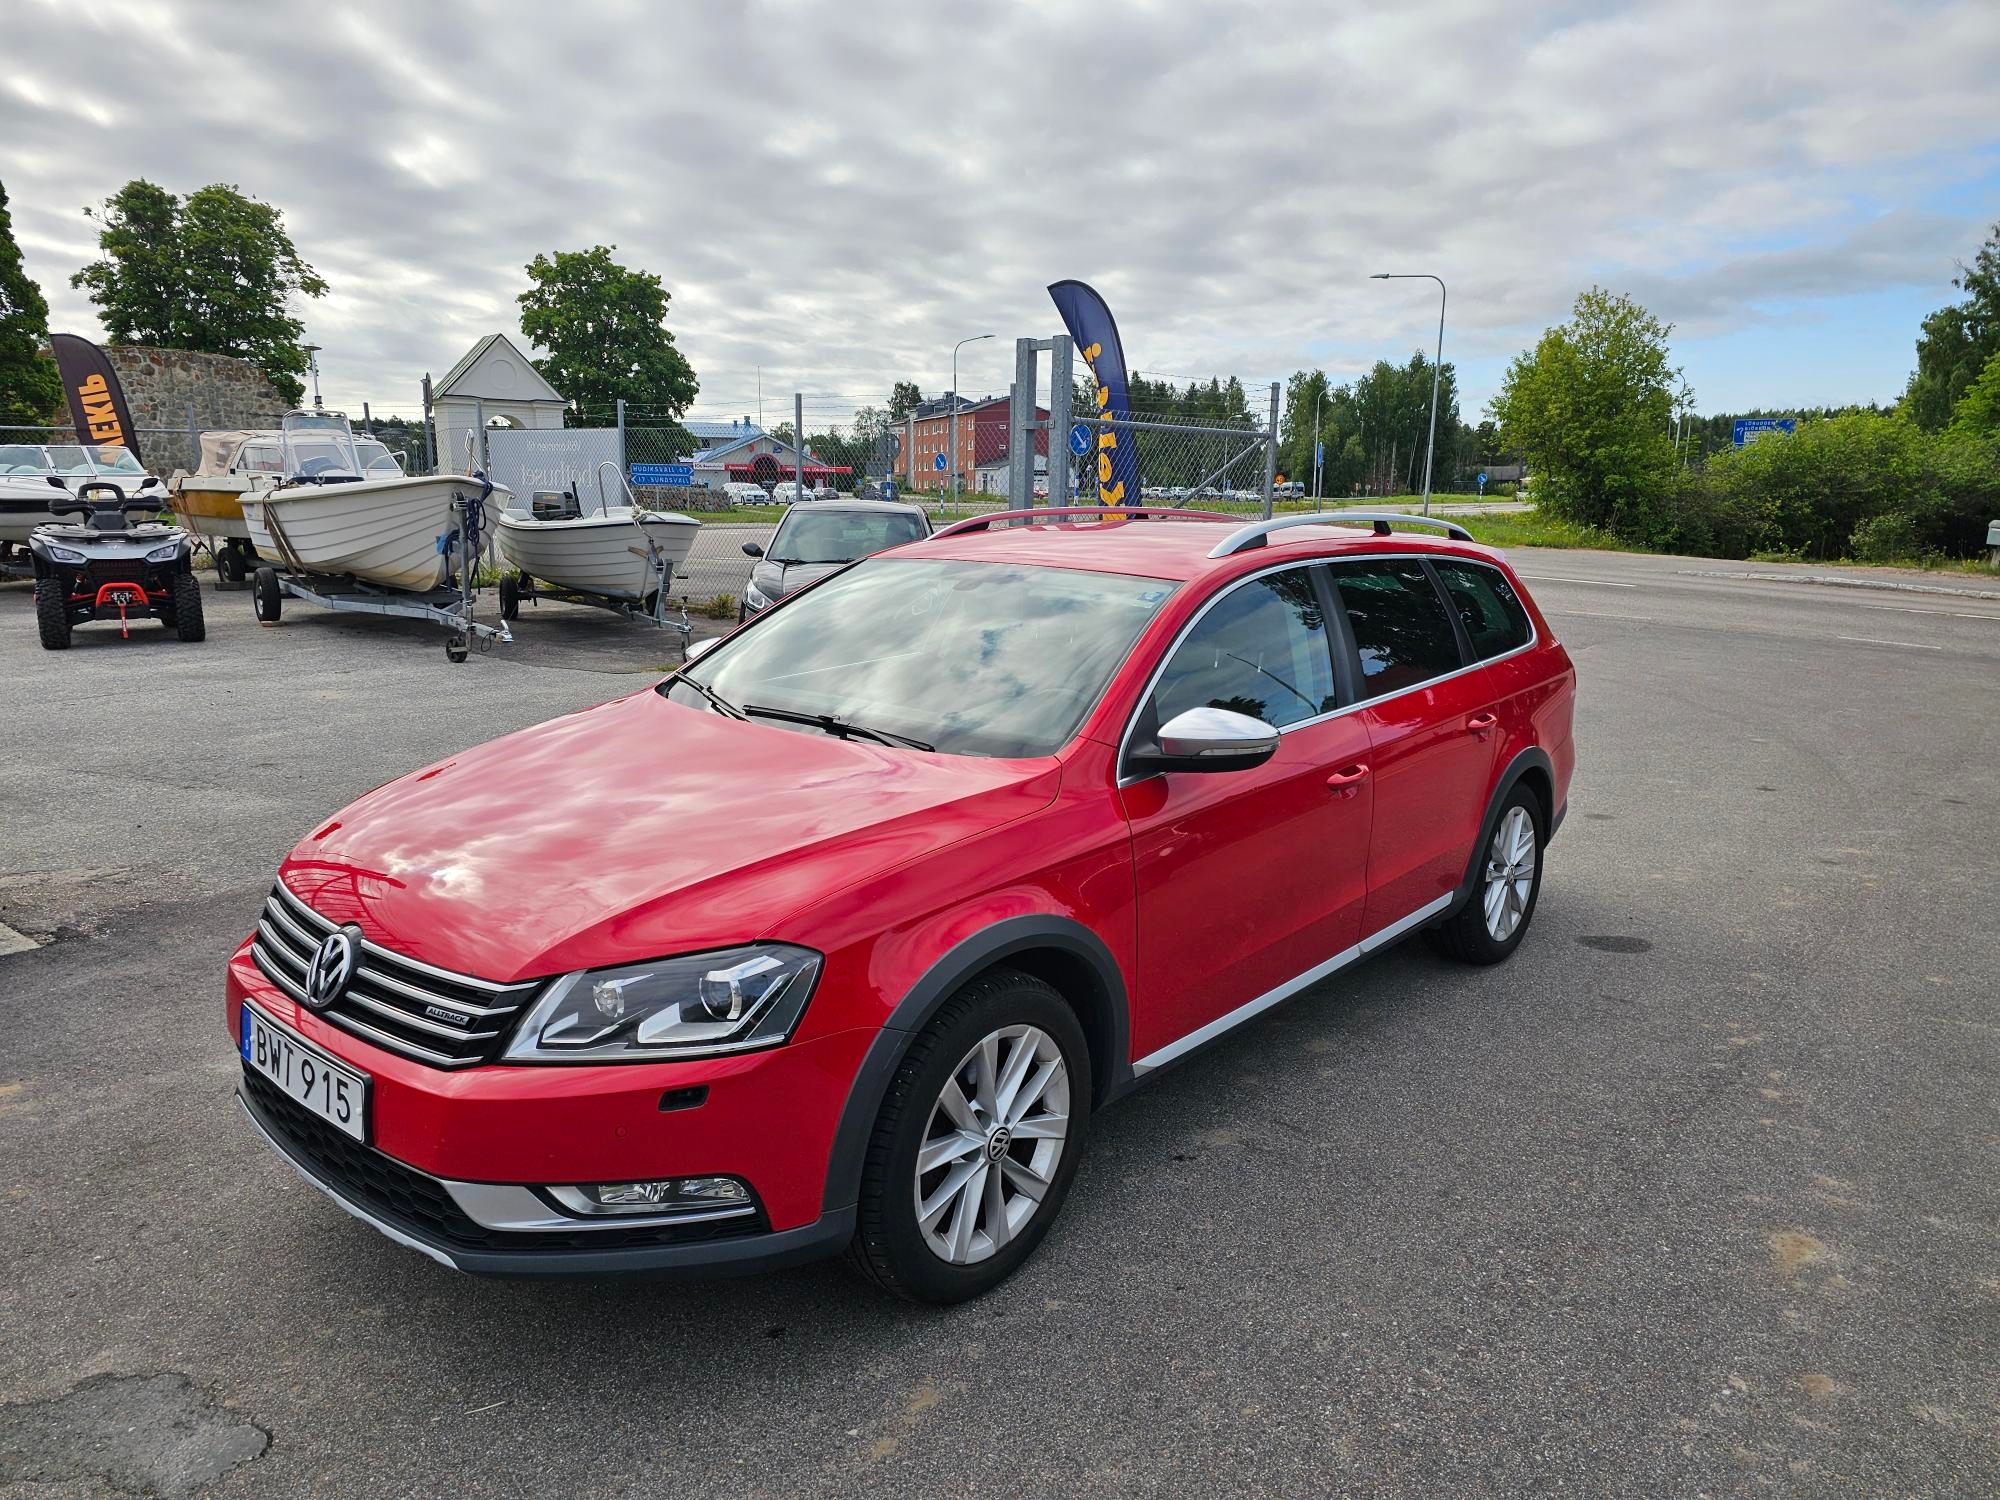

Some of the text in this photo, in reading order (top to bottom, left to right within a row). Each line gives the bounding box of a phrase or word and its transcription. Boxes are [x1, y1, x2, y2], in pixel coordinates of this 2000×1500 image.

[632, 465, 675, 473] HUDIKSVALL
[650, 476, 689, 484] SUNDSVALL
[428, 1008, 465, 1023] ALLTRACK
[257, 1023, 351, 1124] BWT 915
